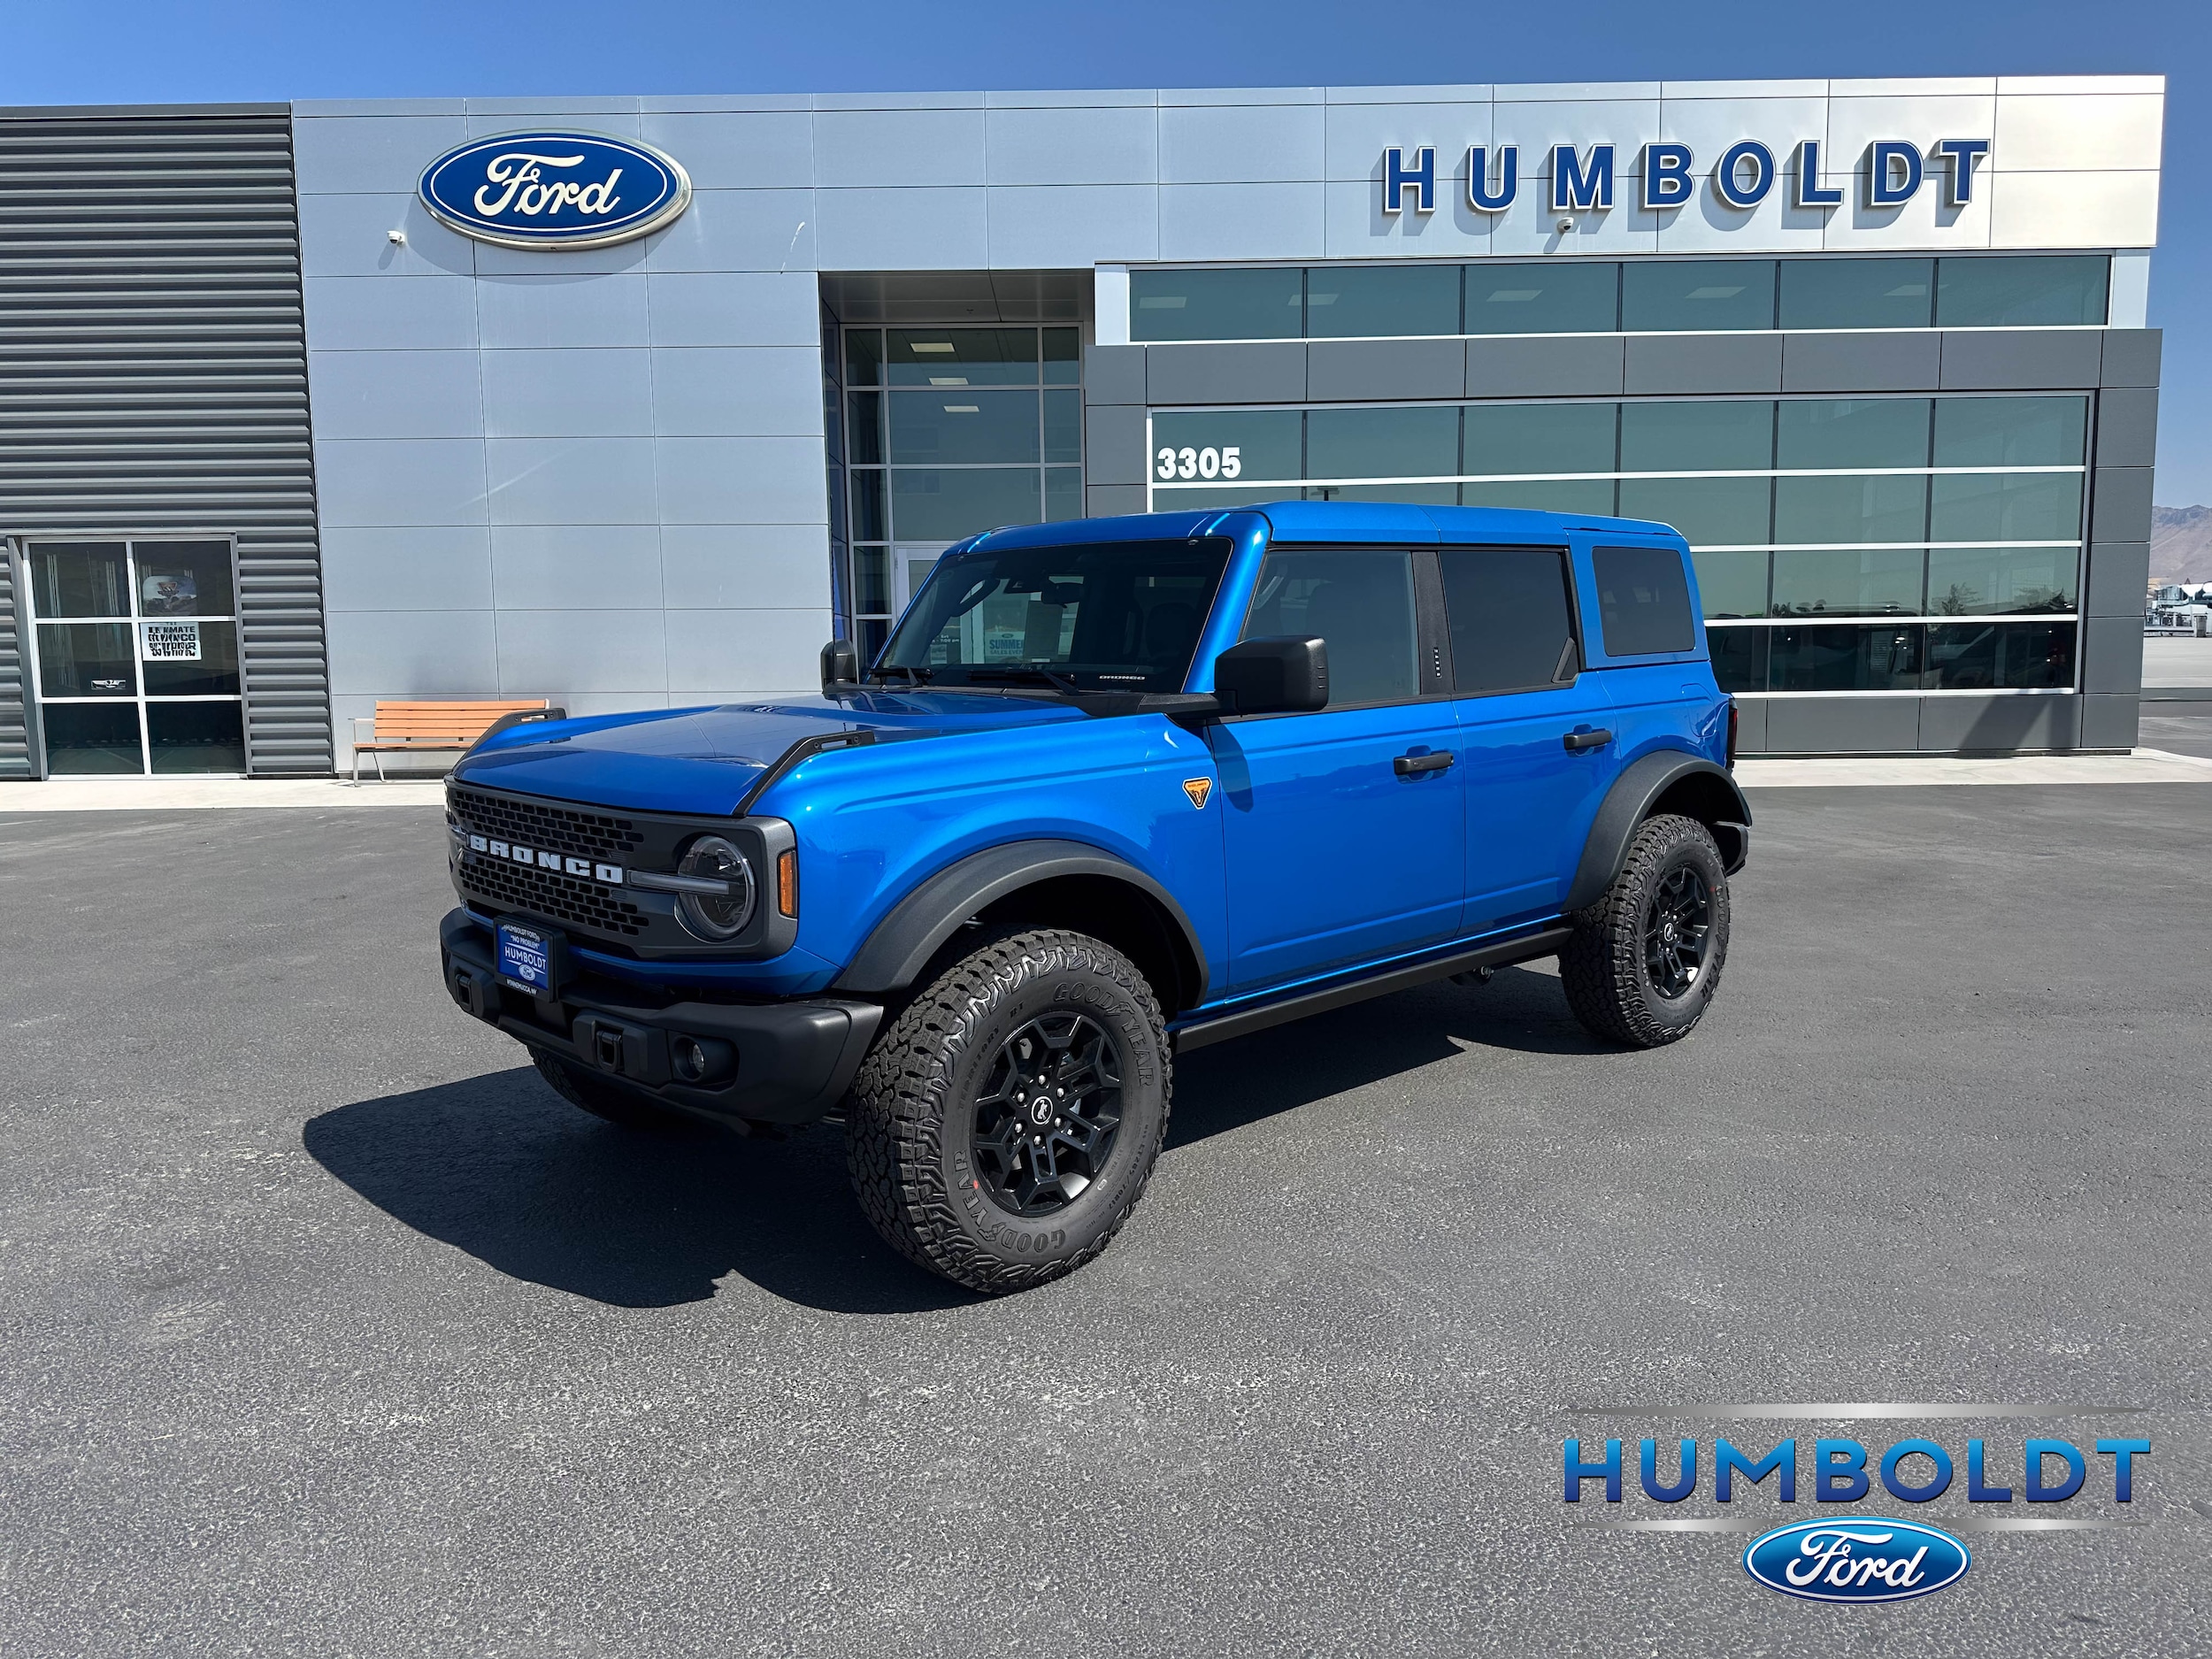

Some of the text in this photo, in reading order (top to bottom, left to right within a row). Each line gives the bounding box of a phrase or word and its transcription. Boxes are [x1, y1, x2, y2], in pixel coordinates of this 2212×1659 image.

[473, 153, 623, 216] Ford
[1385, 139, 1991, 212] HUMBOLDT
[1156, 447, 1241, 480] 3305
[470, 834, 623, 884] BRONCO
[504, 946, 547, 970] HUMBOLDT
[1054, 982, 1155, 1087] GOODYEAR
[954, 1150, 1066, 1253] GOODYEAR
